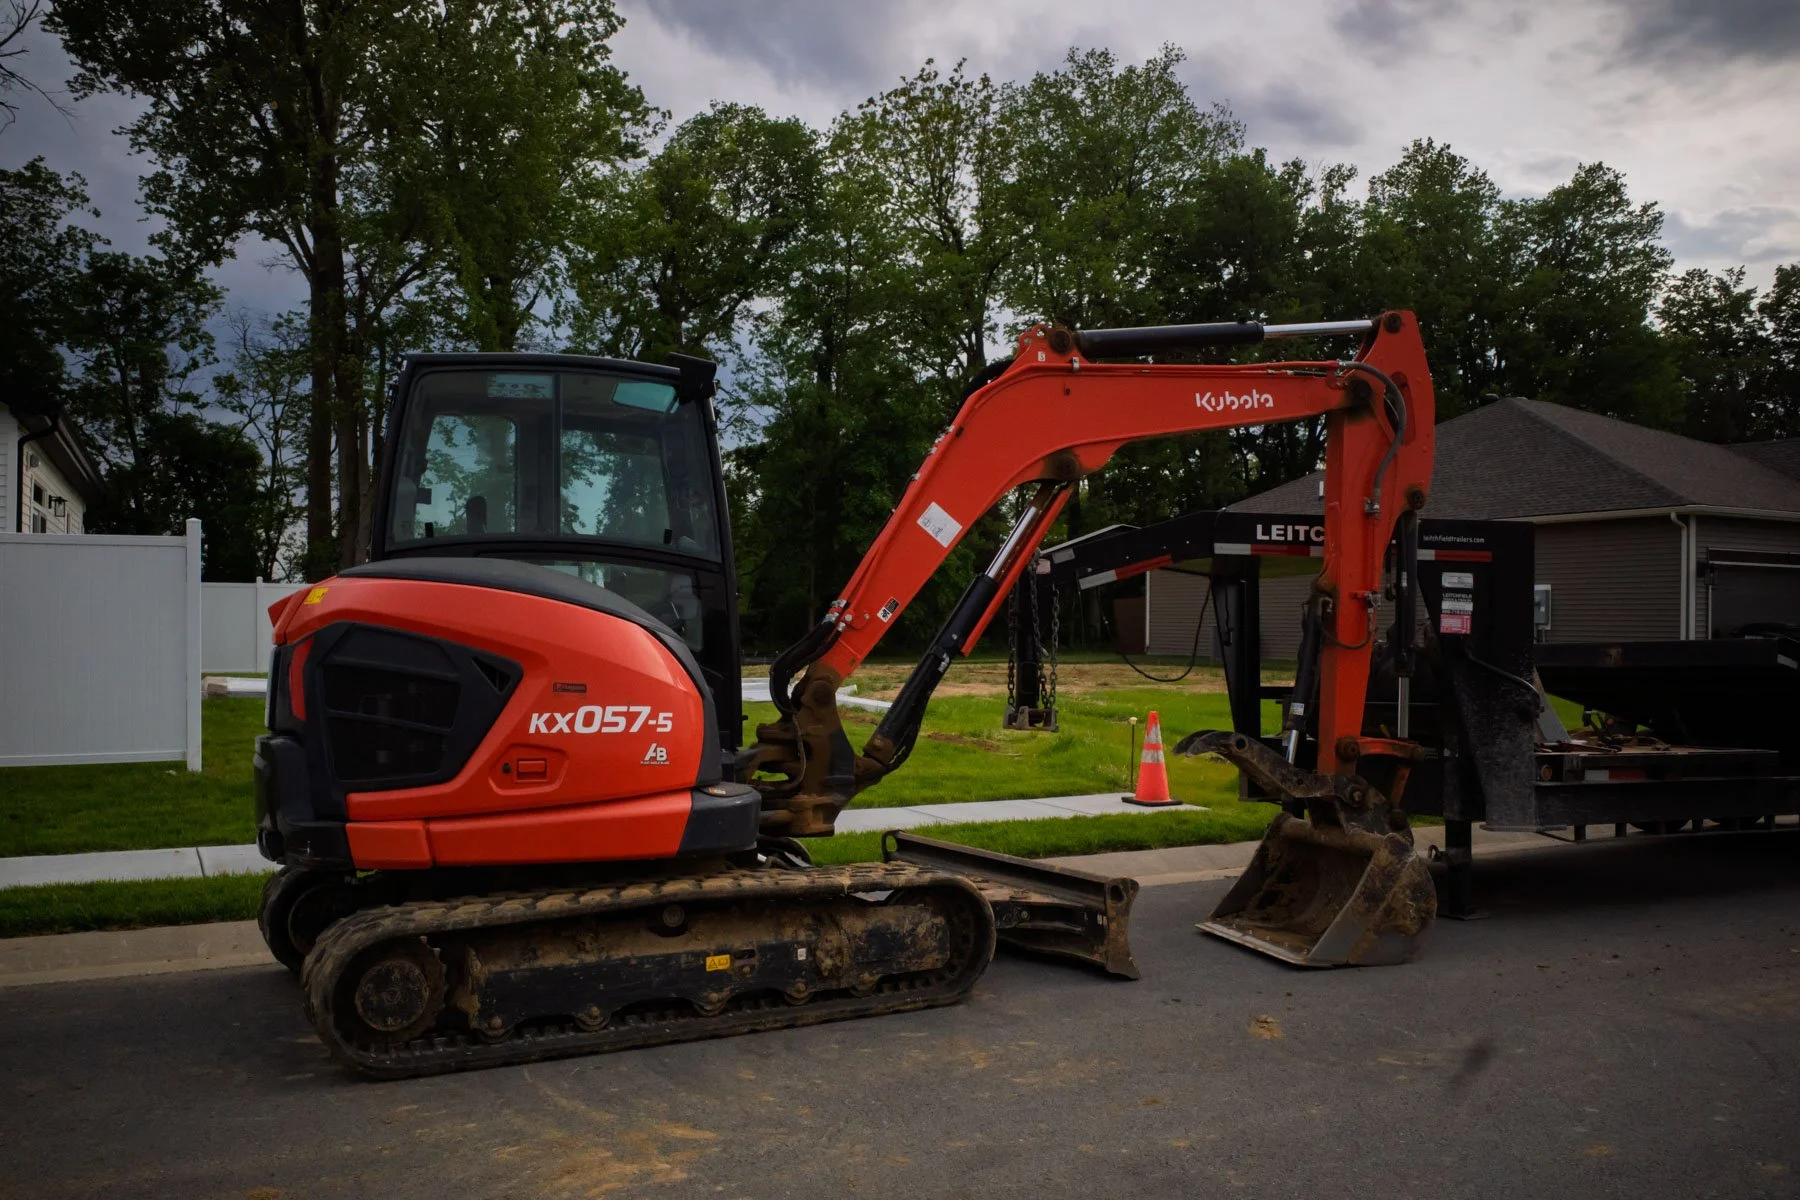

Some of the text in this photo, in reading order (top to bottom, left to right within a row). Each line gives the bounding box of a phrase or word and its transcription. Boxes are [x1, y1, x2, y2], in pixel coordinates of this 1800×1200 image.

[1195, 388, 1274, 412] Kubota
[1423, 535, 1485, 544] leitchfieldtrailers.com
[528, 705, 673, 734] KX057-5
